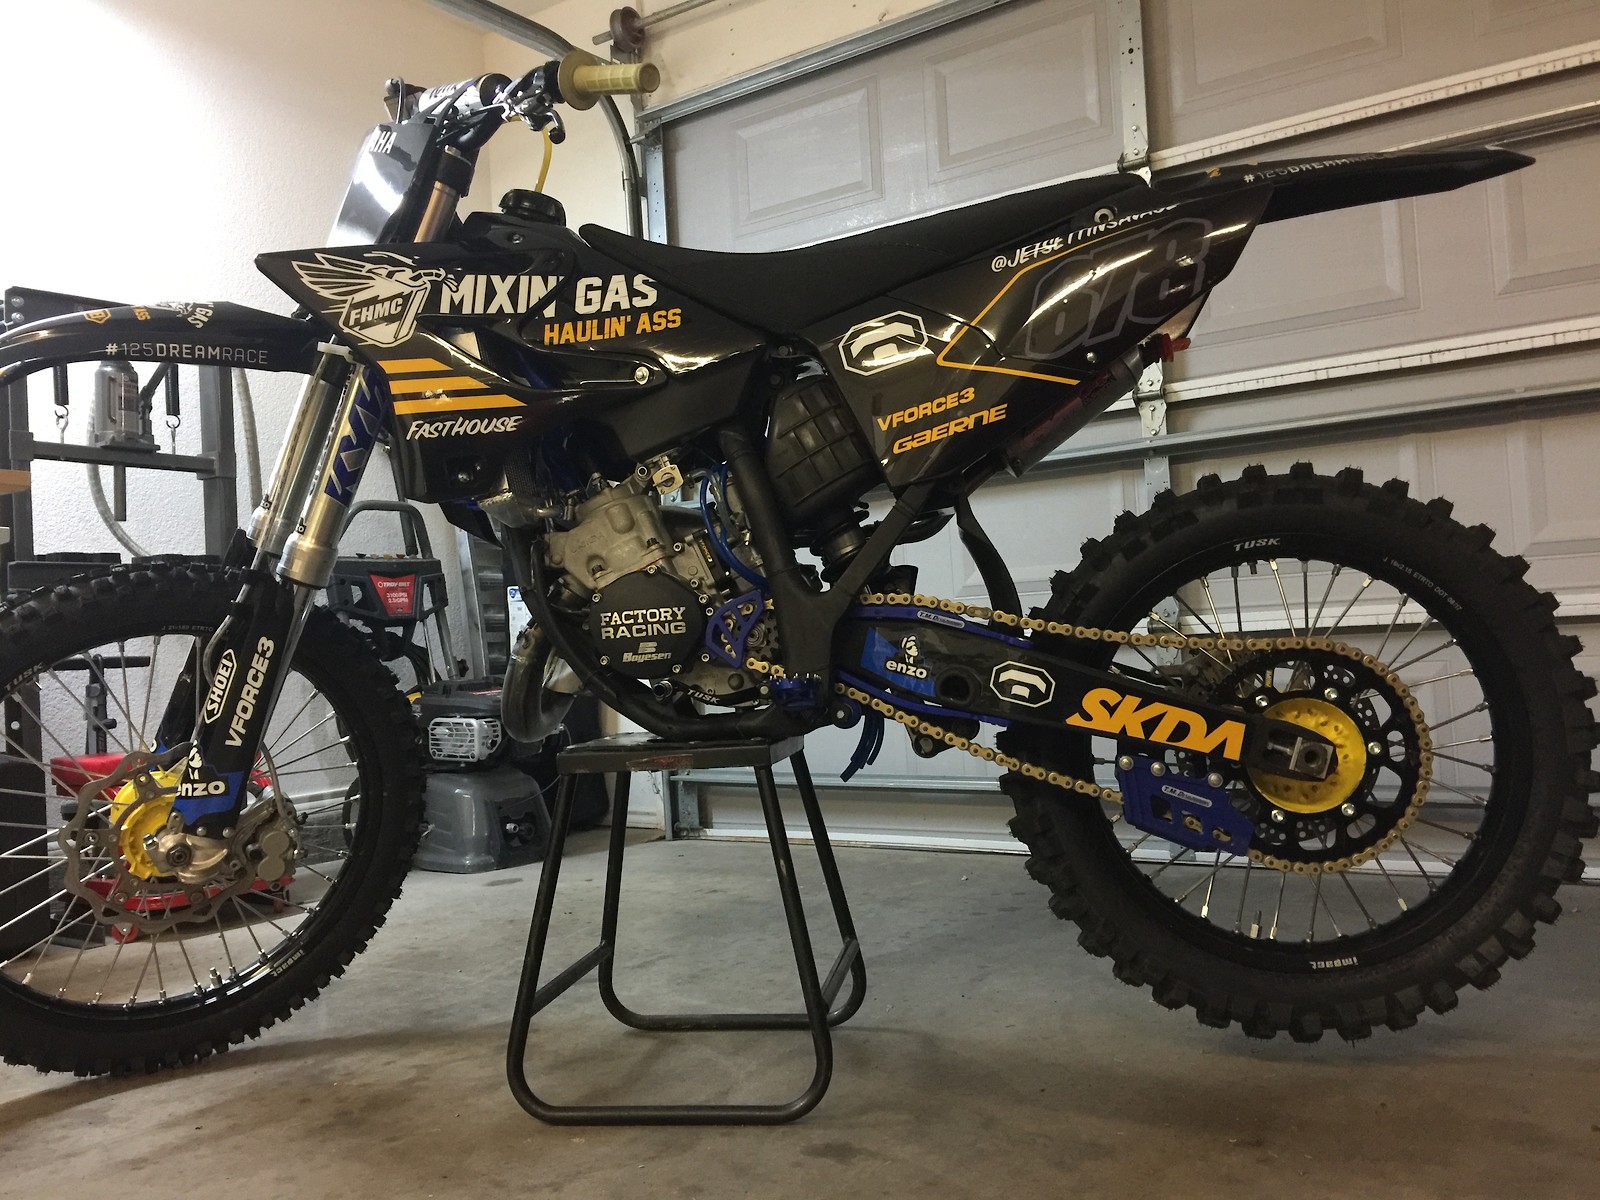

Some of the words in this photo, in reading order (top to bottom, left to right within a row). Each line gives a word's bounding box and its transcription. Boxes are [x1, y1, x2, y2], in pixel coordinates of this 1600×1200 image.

[574, 273, 658, 315] GAS
[349, 296, 403, 327] FHMC
[543, 315, 632, 346] HAULIN'
[636, 307, 682, 334] ASS
[105, 342, 268, 364] #125DREAMRACE
[877, 387, 975, 431] VFORCE3
[406, 415, 523, 440] FASTHOUSE
[1233, 537, 1281, 552] TUSK
[1413, 572, 1434, 588] ETRTO
[1434, 586, 1448, 599] DOT
[600, 606, 686, 626] FACTORY
[601, 621, 686, 639] RACING
[622, 651, 671, 662] Boyesen
[886, 659, 928, 679] enzo
[4, 661, 46, 692] TUSK
[206, 657, 234, 714] SHOEI
[224, 636, 275, 747] VFORCE3
[687, 688, 720, 703] TUSK
[1065, 687, 1246, 761] SKDA
